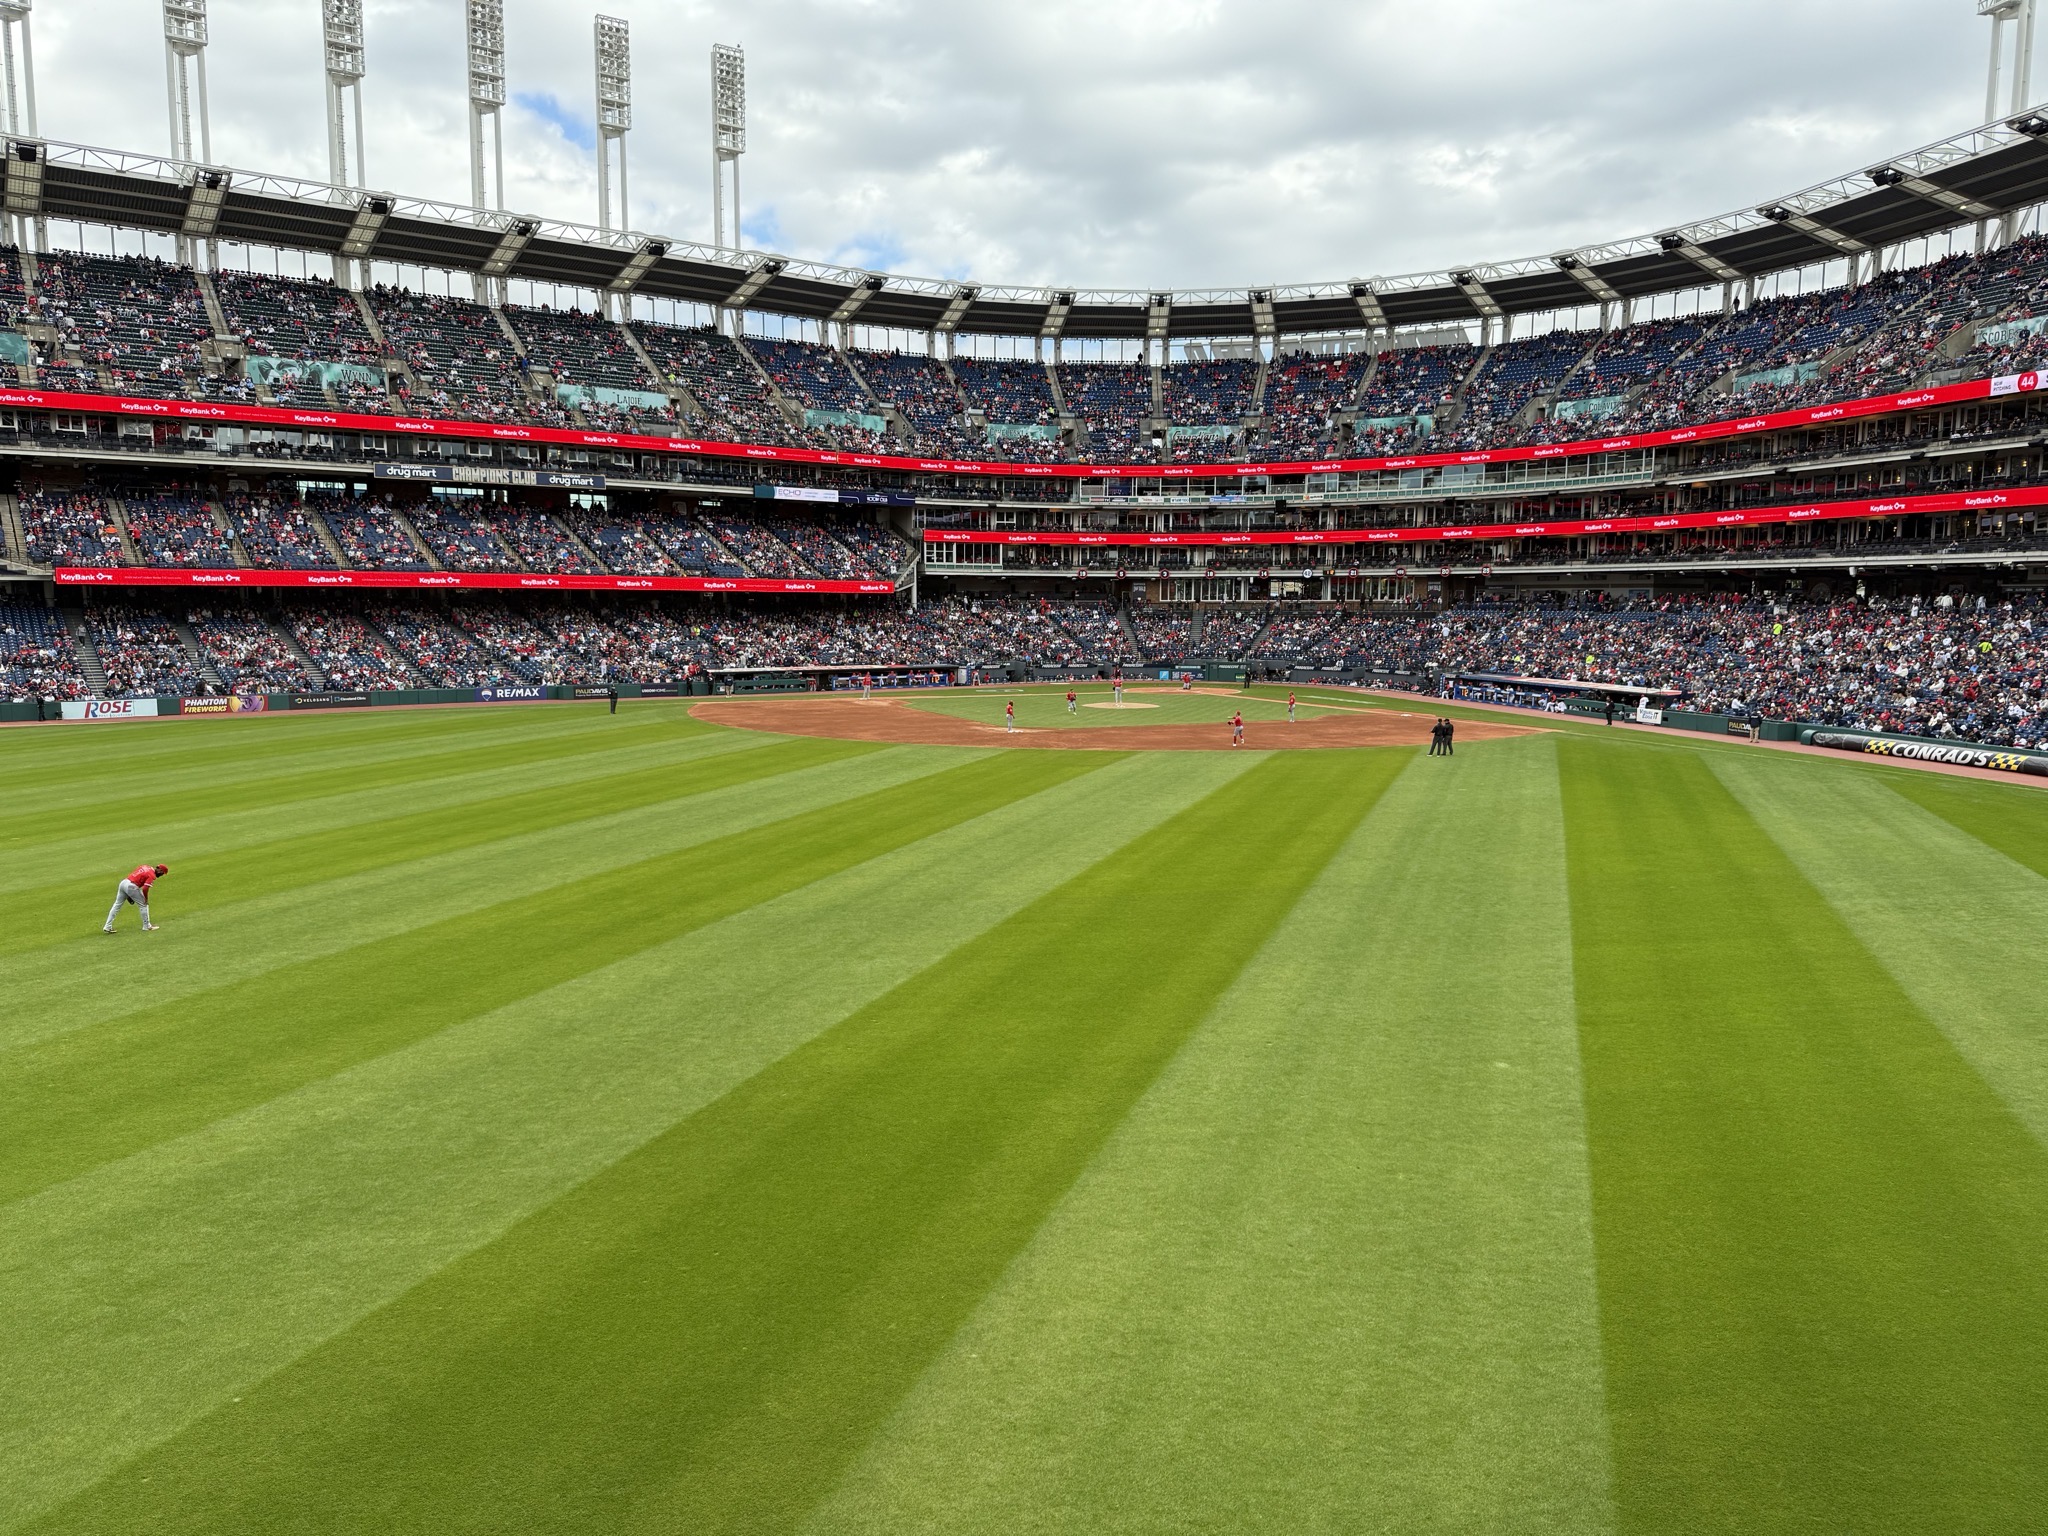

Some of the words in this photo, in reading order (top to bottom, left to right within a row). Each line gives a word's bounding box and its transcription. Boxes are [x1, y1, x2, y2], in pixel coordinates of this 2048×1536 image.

[341, 369, 372, 381] WYNN
[2021, 375, 2034, 388] 44
[617, 394, 642, 409] LAJOIE
[1898, 397, 1921, 405] KeyBank
[1812, 410, 1832, 418] KeyBank
[387, 466, 411, 478] drug
[412, 467, 437, 478] mart
[452, 467, 510, 484] CHAMPIONS
[512, 470, 537, 485] CLUB
[549, 475, 571, 487] drug
[572, 477, 594, 486] mart
[778, 488, 802, 497] ECHO
[1966, 497, 1992, 505] KeyBank
[497, 688, 539, 698] RE/MAX
[184, 697, 227, 706] PHANTOM
[84, 700, 133, 718] ROSE
[184, 705, 228, 713] FIREWORKS
[1892, 743, 1993, 767] CONRAD'S
